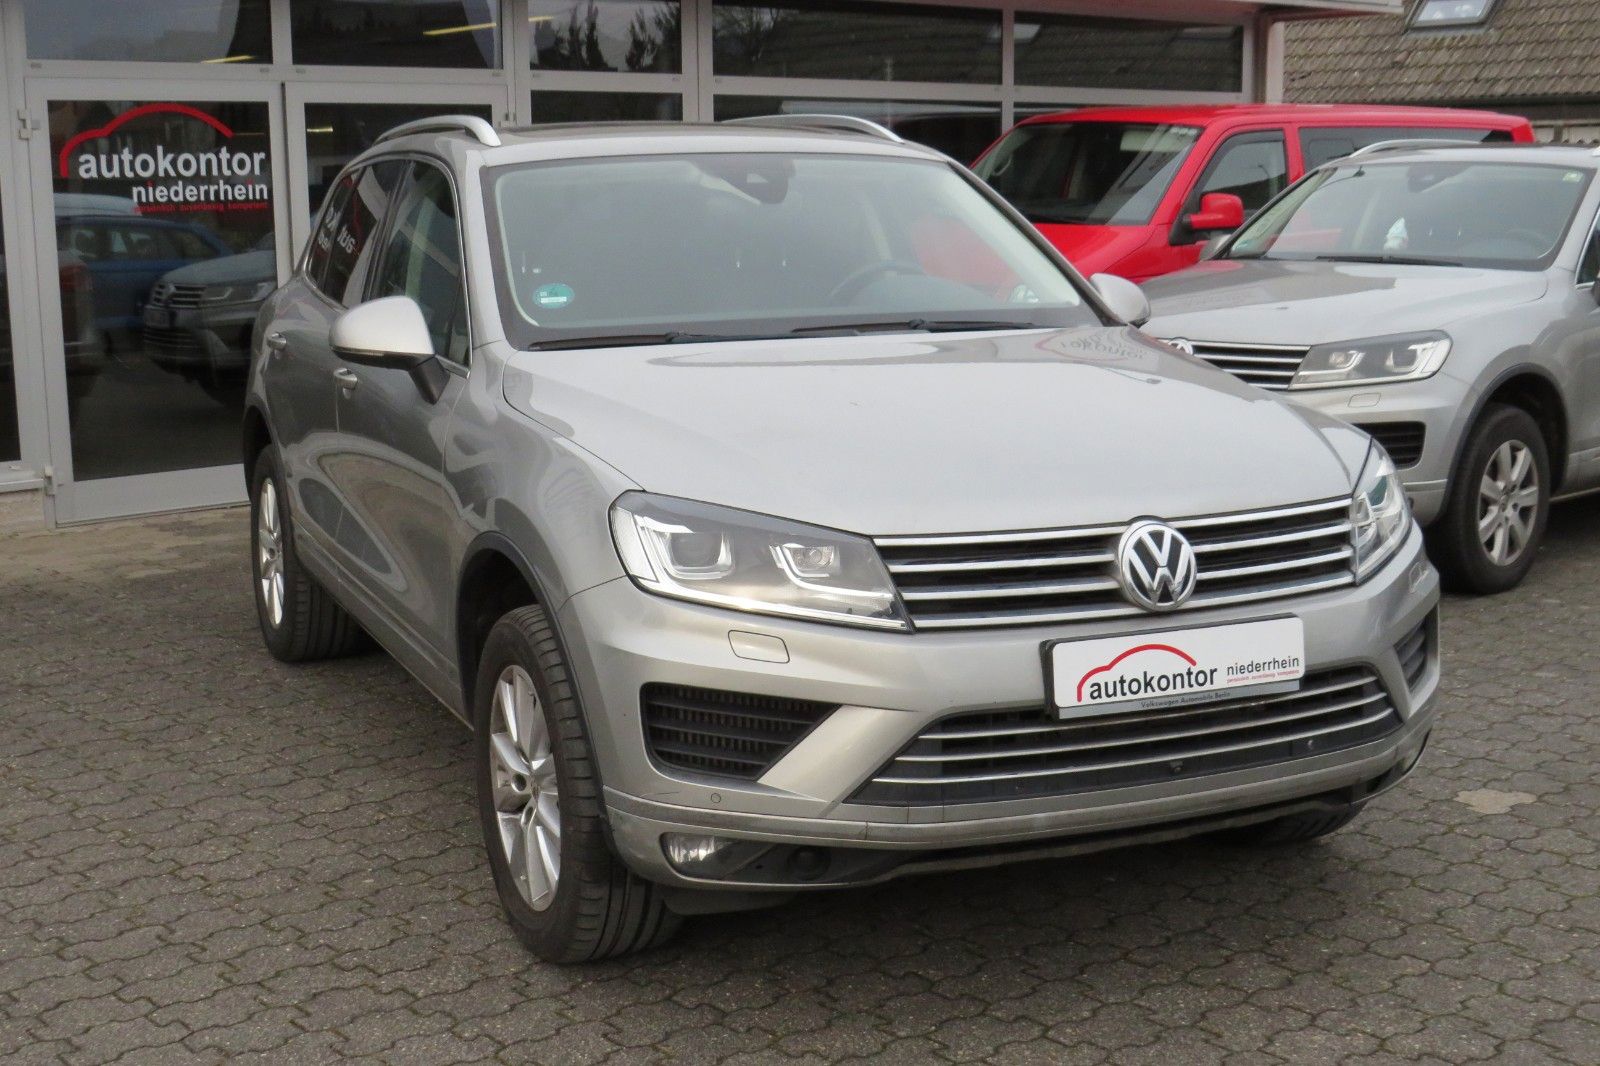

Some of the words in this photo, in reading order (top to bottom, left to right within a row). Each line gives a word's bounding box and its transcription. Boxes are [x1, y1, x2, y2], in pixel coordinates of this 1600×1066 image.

[78, 145, 266, 179] autokontor
[132, 179, 269, 203] niederrhein
[1124, 525, 1196, 609] VW
[1089, 665, 1218, 701] autokontor
[1227, 655, 1300, 676] niederrhein
